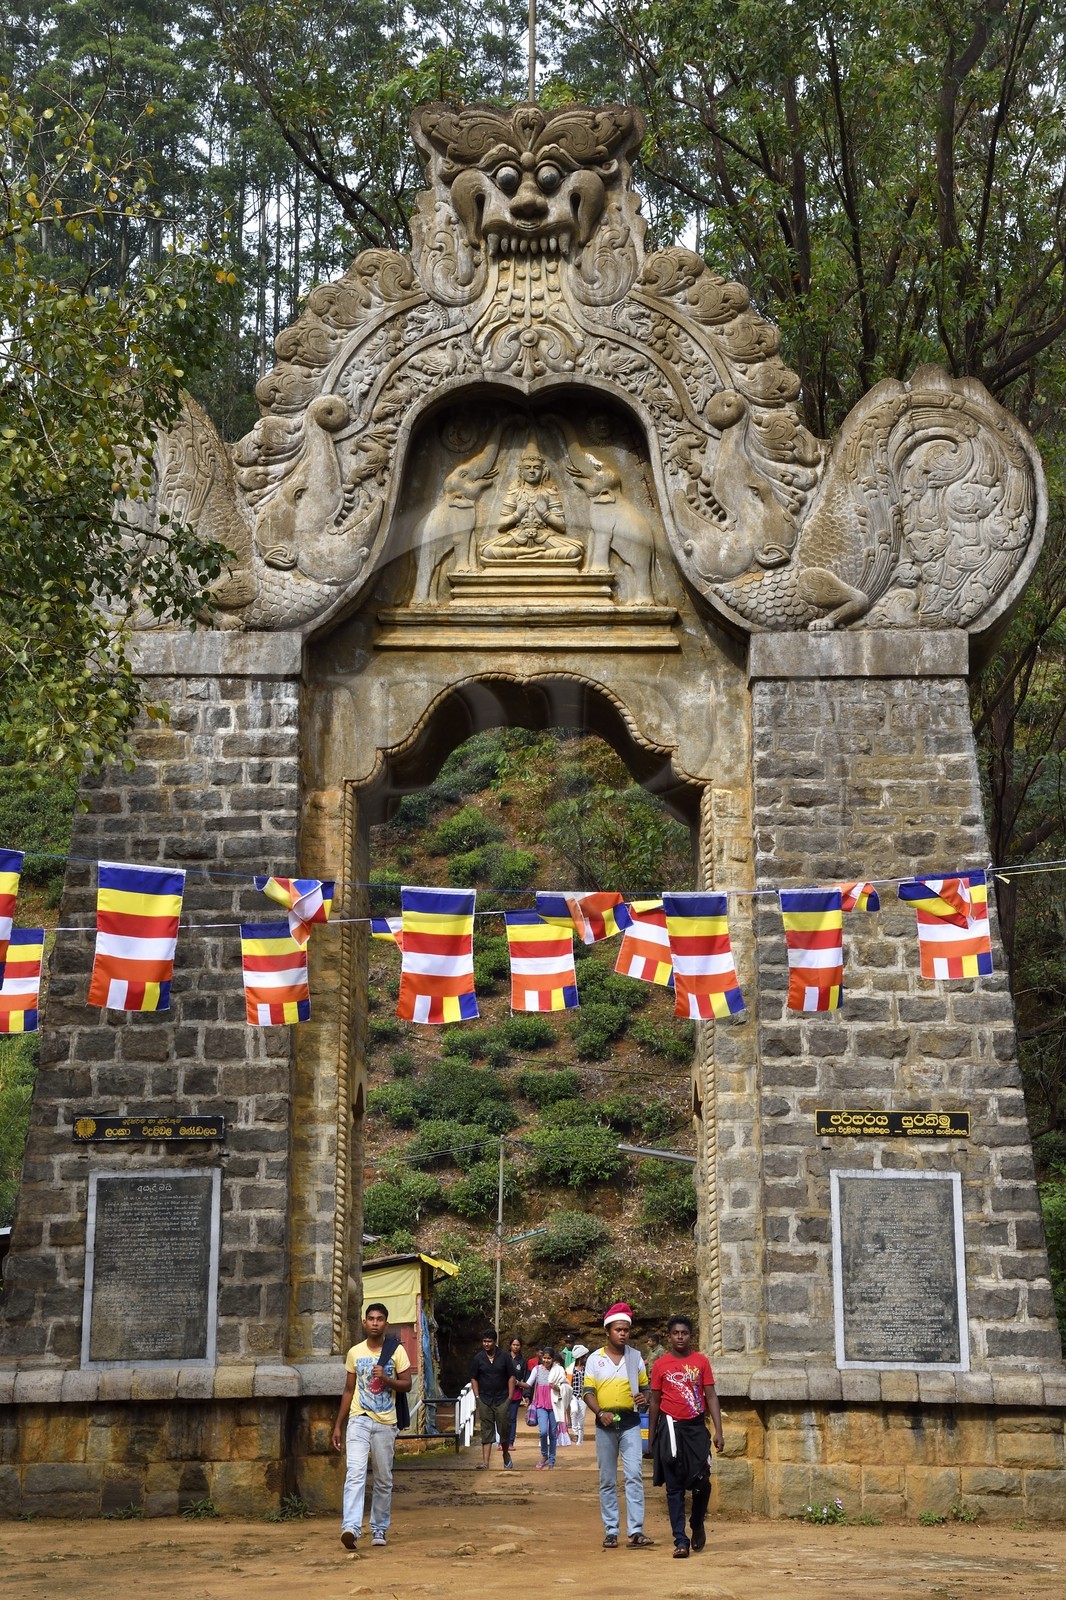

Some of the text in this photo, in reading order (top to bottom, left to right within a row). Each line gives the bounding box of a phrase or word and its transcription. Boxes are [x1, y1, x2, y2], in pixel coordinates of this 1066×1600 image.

[830, 1111, 951, 1128] පරිසරය සුරකිමු
[105, 1126, 217, 1137] ලංකා විදුලිබල මණ්ඩලය
